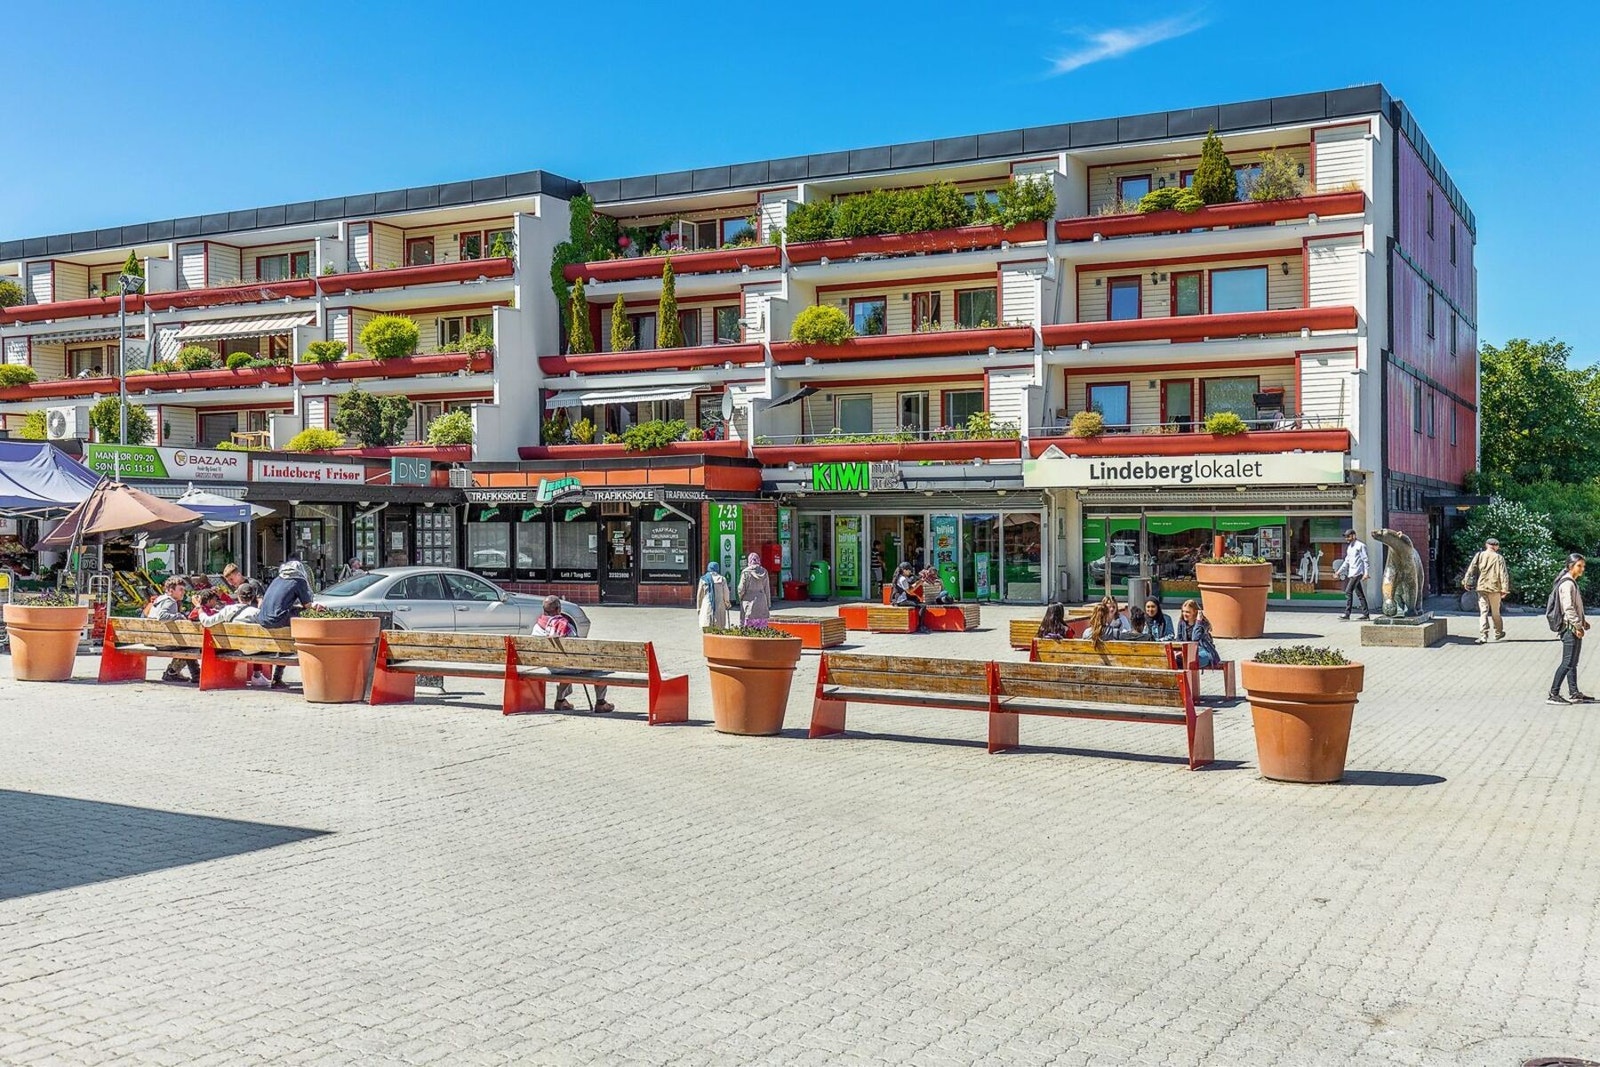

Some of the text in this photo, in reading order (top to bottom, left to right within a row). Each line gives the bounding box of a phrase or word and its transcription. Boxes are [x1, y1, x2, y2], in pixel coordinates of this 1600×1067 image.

[134, 453, 155, 462] 09-20
[189, 455, 238, 466] BAZAAR
[134, 464, 155, 473] 11-18
[263, 465, 360, 481] Lindeberg Frisør
[400, 462, 427, 480] DNB
[1089, 459, 1263, 483] Lindeberglokalet
[811, 462, 870, 491] KIWI
[471, 492, 527, 501] TRAFIKKSKOLE
[594, 491, 654, 500] TRAFIKKSKOLE
[665, 490, 705, 500] TRAFIKKSKOLE
[718, 504, 738, 518] 7-23
